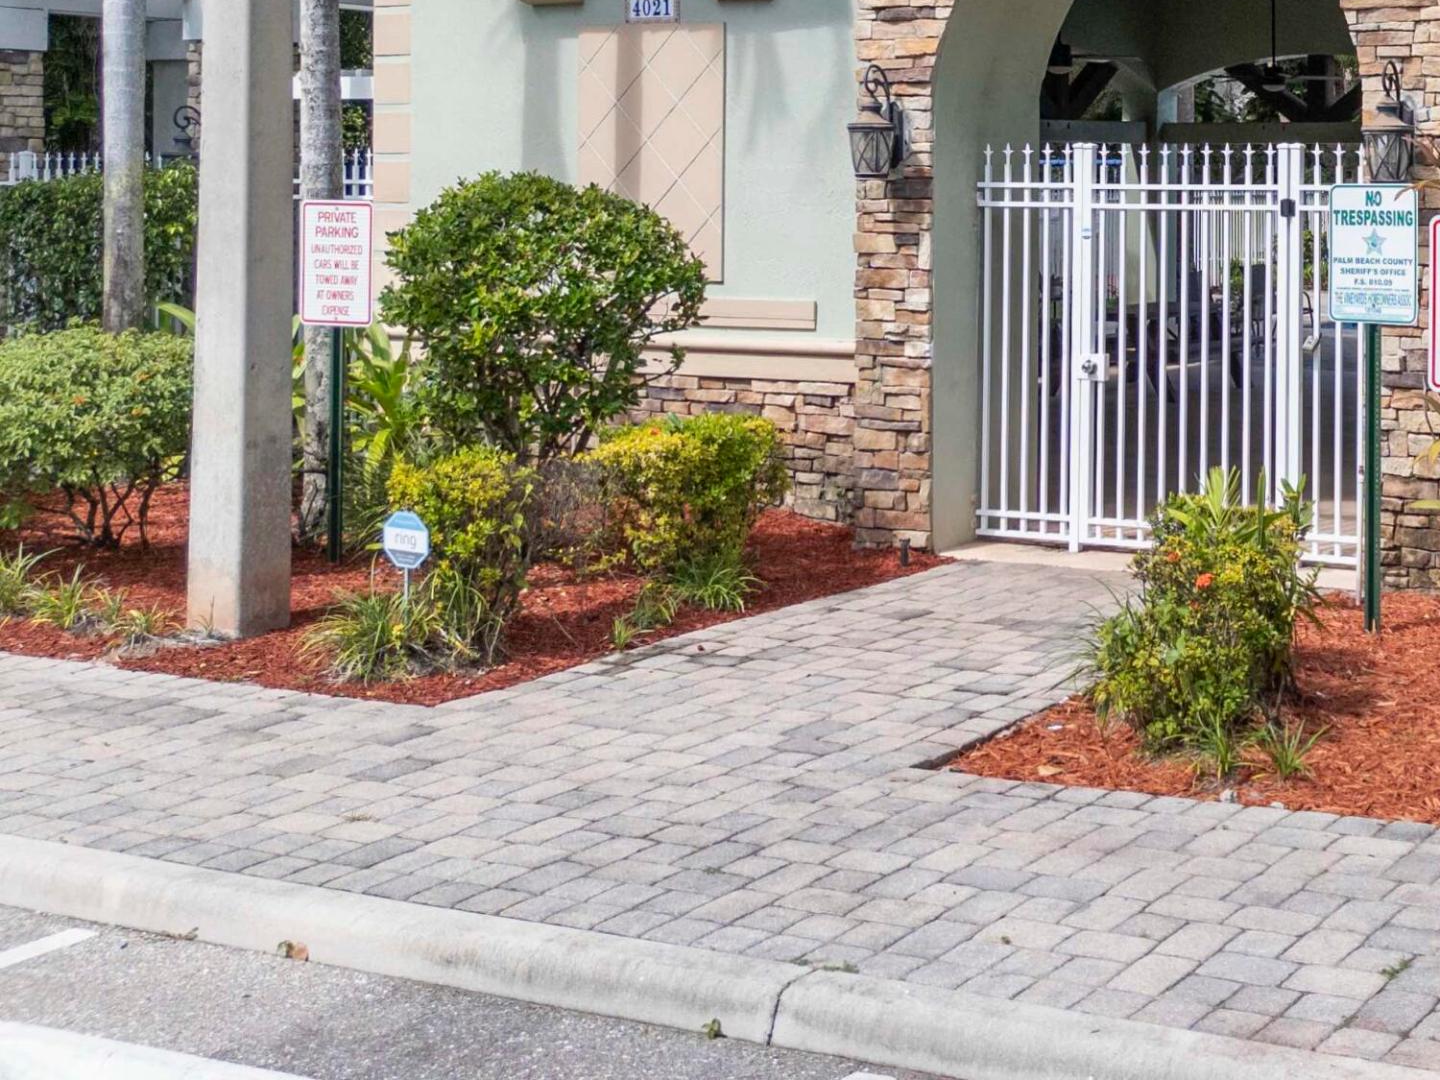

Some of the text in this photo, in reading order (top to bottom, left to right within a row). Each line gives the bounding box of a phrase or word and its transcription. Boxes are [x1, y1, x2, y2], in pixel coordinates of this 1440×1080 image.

[1365, 191, 1382, 206] NO
[317, 211, 357, 223] PRIVATE
[1334, 210, 1413, 226] TRESPASSING
[315, 226, 359, 238] PARKING
[311, 243, 363, 255] UNAUTHORIZED
[313, 259, 359, 270] CARS WILL BE
[1355, 257, 1380, 265] BEACH
[1380, 268, 1406, 276] OFFICE
[315, 274, 358, 285] TOWED AWAY
[317, 289, 354, 301] AT OWNERS
[322, 305, 350, 316] EXPENSE
[395, 533, 416, 549] ring
